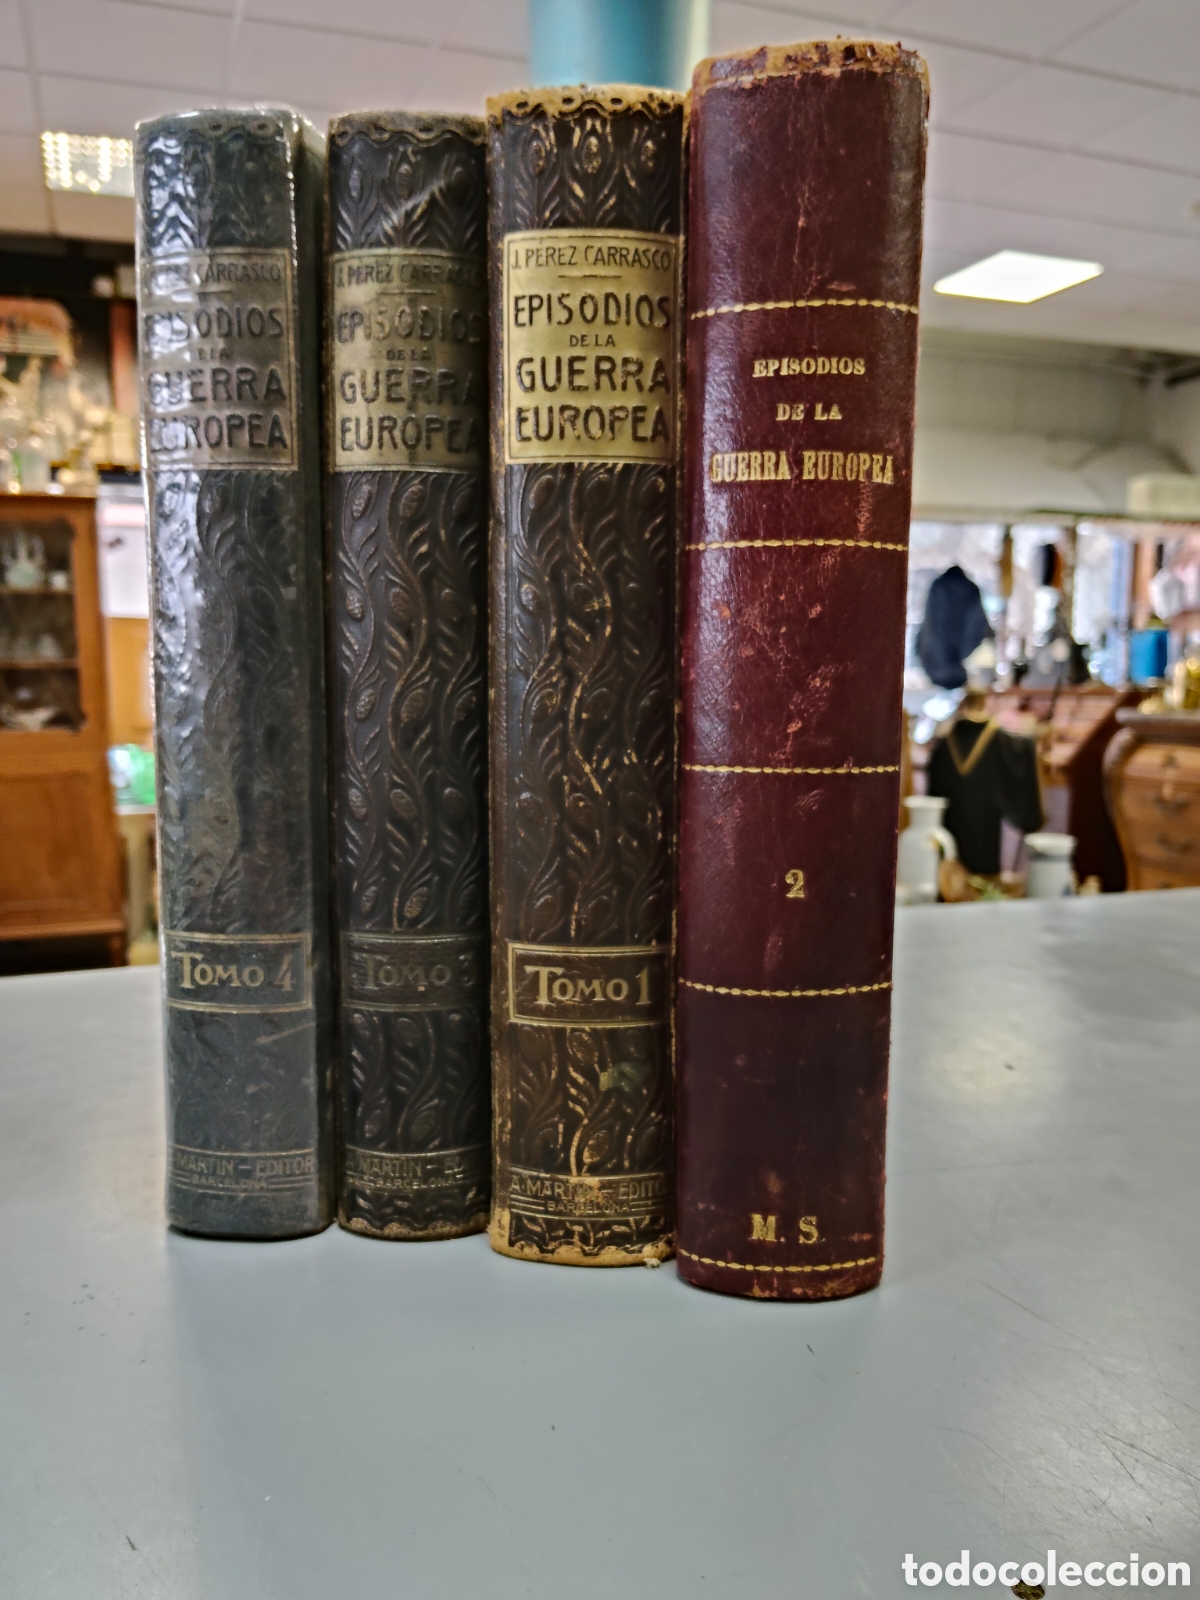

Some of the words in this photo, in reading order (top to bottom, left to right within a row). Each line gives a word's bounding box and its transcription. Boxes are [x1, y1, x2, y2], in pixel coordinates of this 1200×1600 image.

[584, 245, 672, 271] CARRASCO
[513, 291, 671, 329] EPISODIOS
[569, 334, 590, 347] DE
[594, 334, 616, 347] LA
[516, 355, 671, 395] GUERRA
[752, 357, 866, 378] EPISODIOS
[515, 404, 670, 443] EUROPEA
[775, 403, 805, 421] DE
[814, 402, 842, 420] LA
[709, 451, 792, 483] GUERRA
[802, 450, 894, 485] EUROPEA
[784, 868, 805, 899] 2
[275, 954, 294, 992] 4
[635, 966, 650, 1005] 1
[546, 1201, 631, 1214] BARCELONA
[748, 1213, 786, 1243] M.
[798, 1215, 826, 1244] S.
